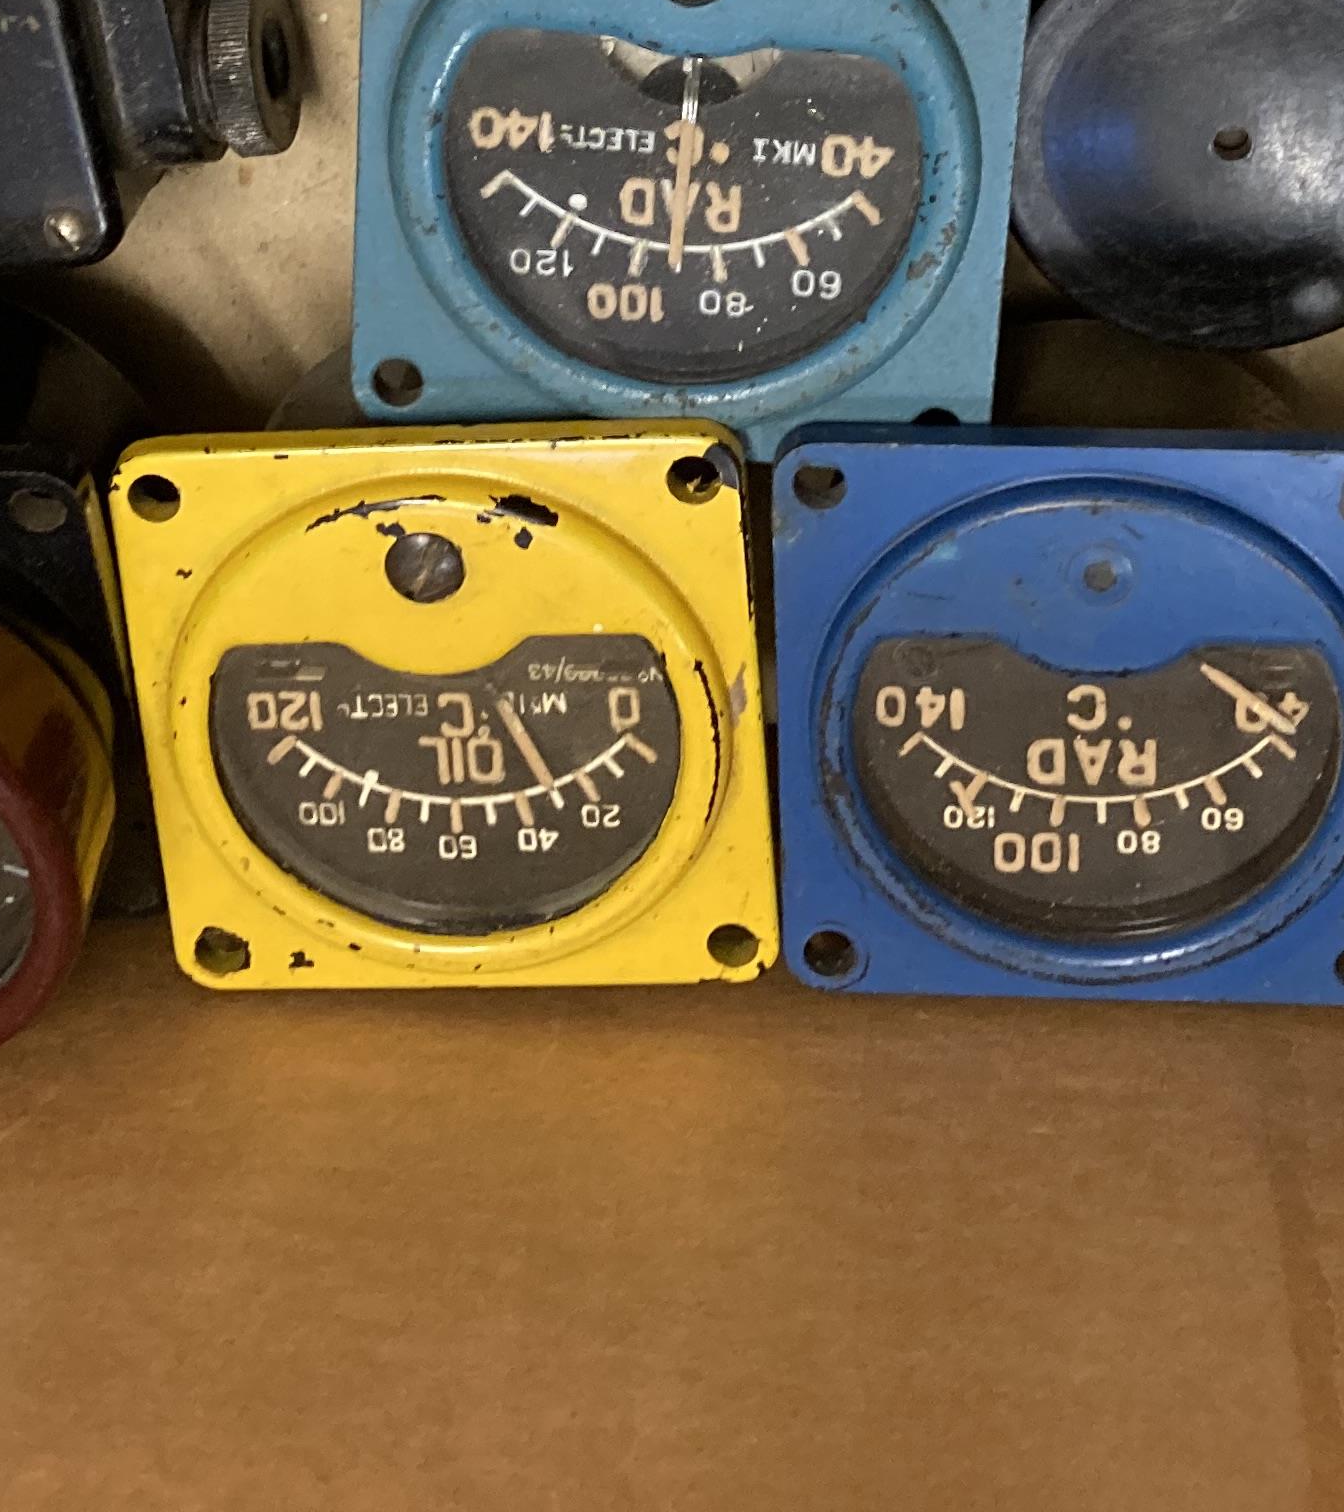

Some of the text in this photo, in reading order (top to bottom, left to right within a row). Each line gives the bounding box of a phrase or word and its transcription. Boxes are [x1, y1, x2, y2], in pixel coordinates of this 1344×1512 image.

[468, 105, 552, 152] 140
[820, 134, 895, 180] 40
[509, 248, 574, 277] 120
[791, 270, 842, 299] 60
[587, 283, 665, 322] 100
[699, 290, 754, 317] 80
[247, 691, 323, 731] 120
[609, 687, 640, 731] 0
[875, 686, 965, 730] 140
[418, 736, 504, 785] OIL
[1027, 738, 1156, 786] RAD
[298, 802, 346, 825] 100
[580, 804, 622, 828] 20
[943, 805, 995, 829] 120
[1201, 807, 1244, 831] 60
[367, 828, 405, 853] 80
[438, 834, 478, 860] 60
[518, 827, 559, 851] 40
[993, 832, 1080, 873] 100
[1117, 830, 1161, 854] 80
